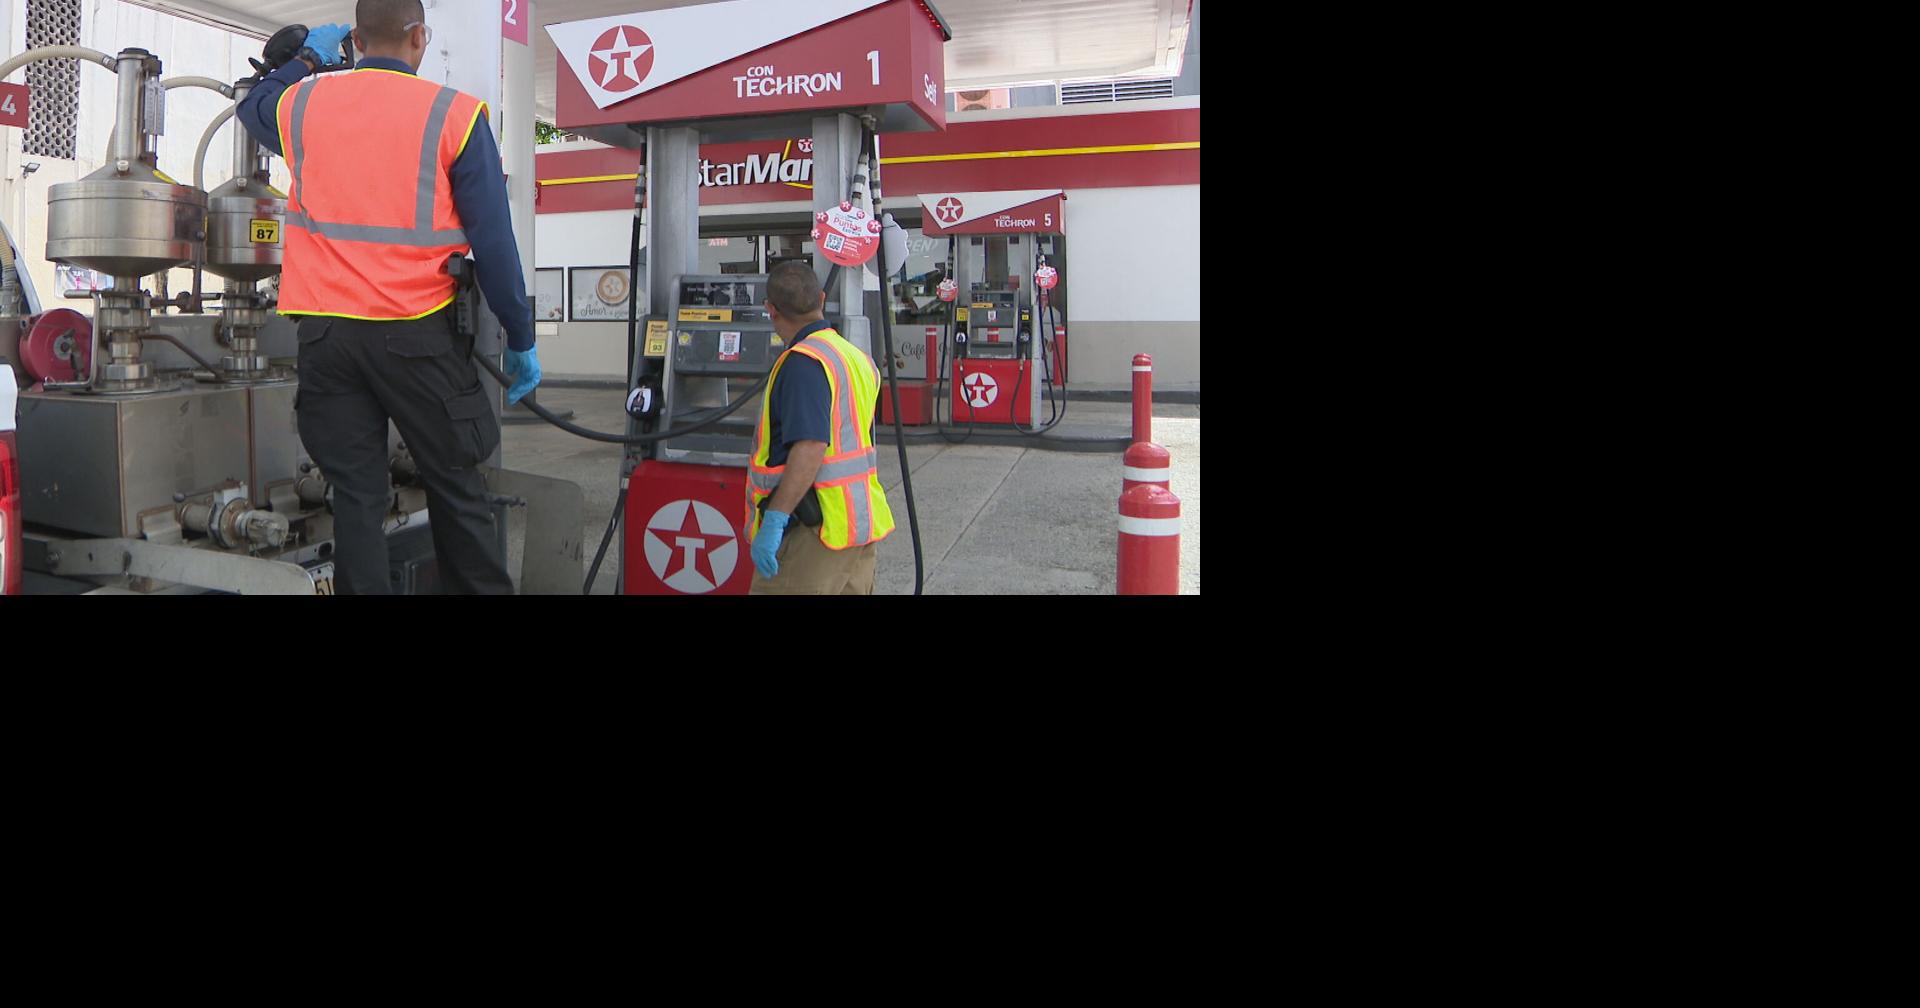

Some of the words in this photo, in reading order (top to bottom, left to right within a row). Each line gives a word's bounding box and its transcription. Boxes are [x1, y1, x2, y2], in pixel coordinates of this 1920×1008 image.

[503, 0, 517, 26] 2
[746, 65, 774, 77] CON
[866, 50, 880, 86] 1
[732, 71, 842, 98] TECHRON
[1, 94, 17, 116] 4
[994, 218, 1036, 228] TECHRON
[1044, 213, 1052, 226] 5
[256, 228, 274, 240] 87
[708, 238, 728, 247] ATM
